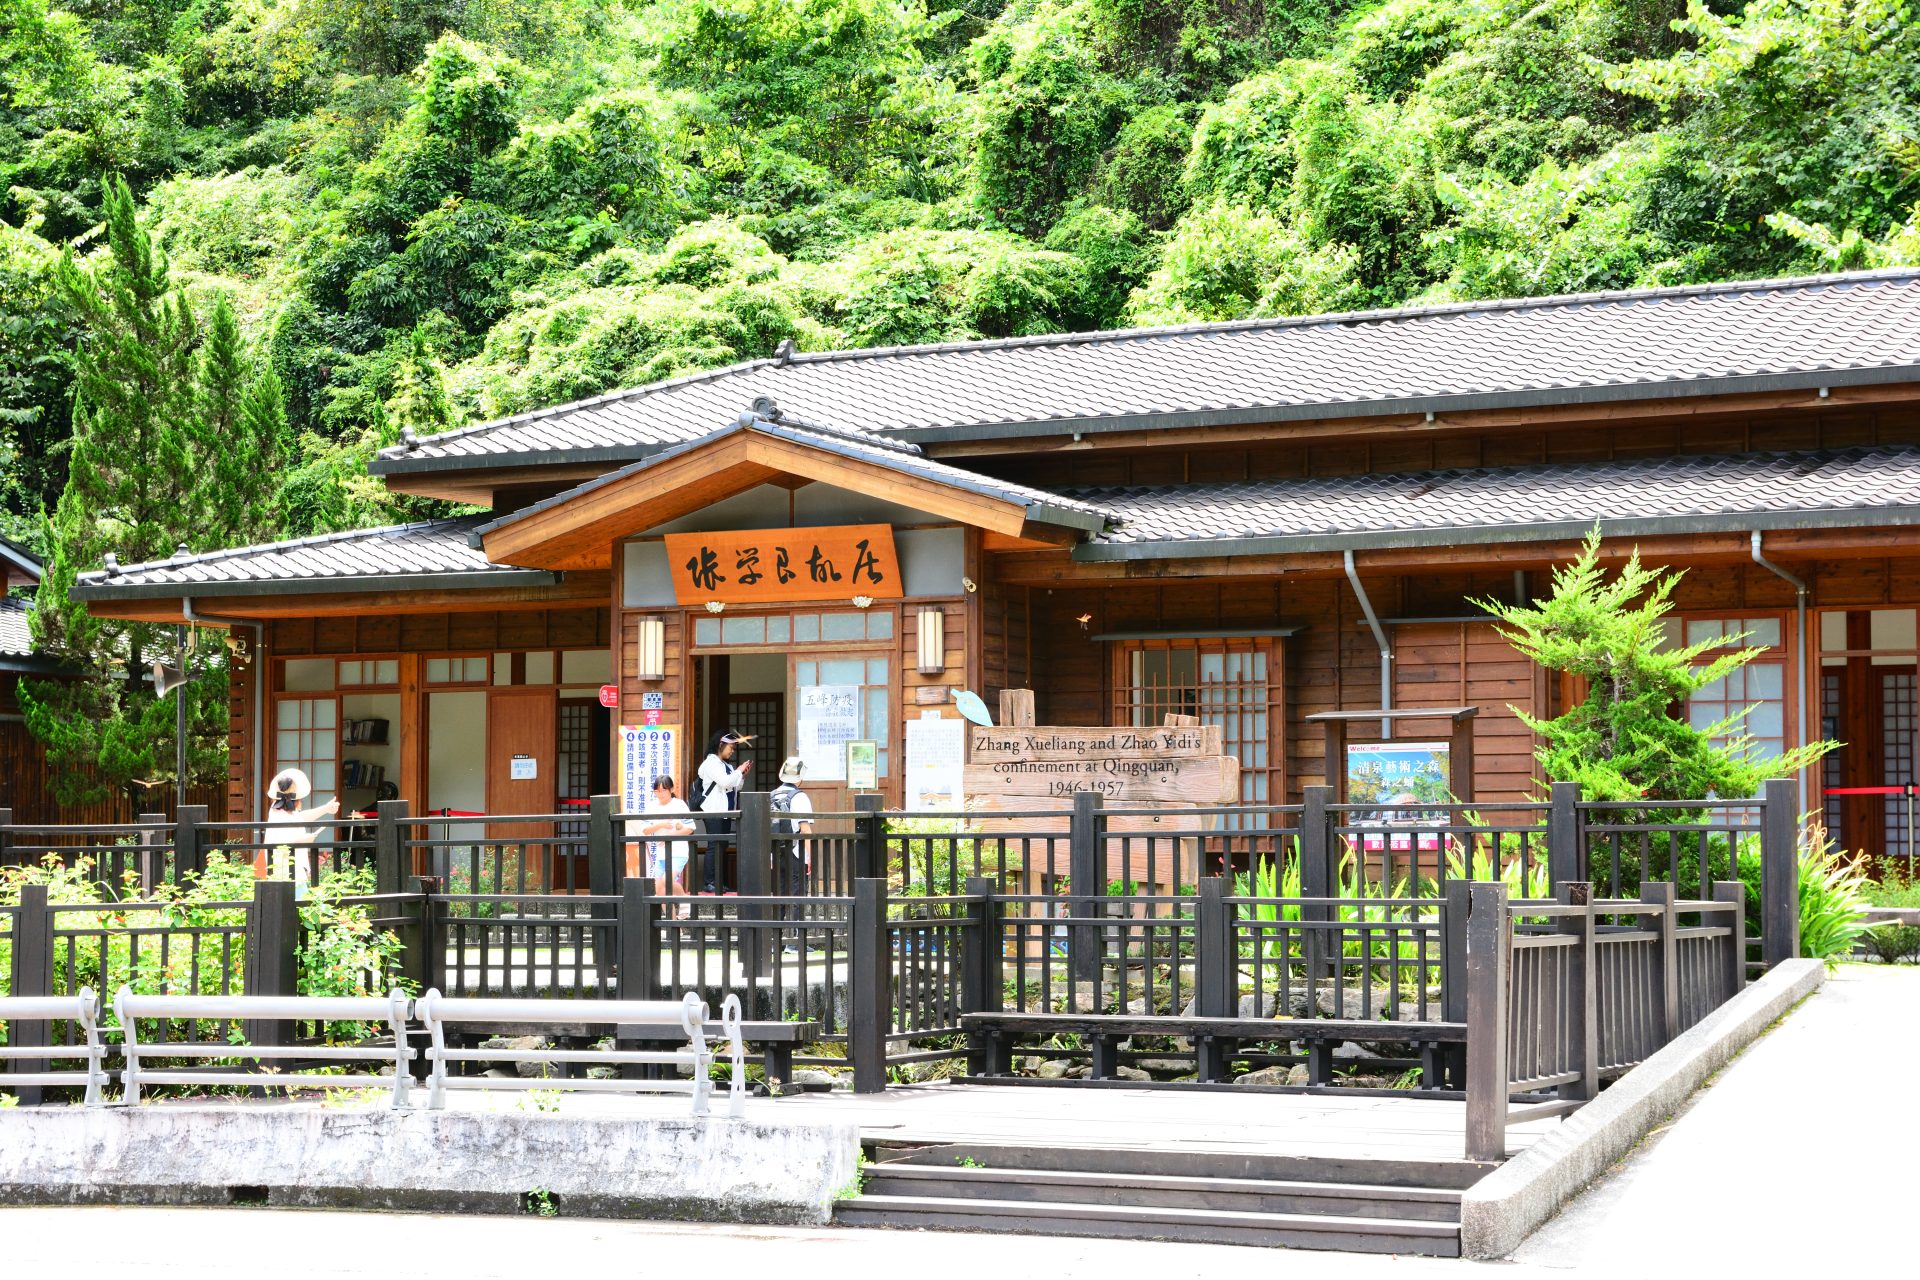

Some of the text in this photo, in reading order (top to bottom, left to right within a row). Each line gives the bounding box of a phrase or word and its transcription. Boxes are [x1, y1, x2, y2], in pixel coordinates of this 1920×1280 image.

[976, 736, 1020, 754] Zhang
[1025, 735, 1086, 755] Xueliang
[1090, 735, 1116, 751] and
[1121, 735, 1158, 751] Zhao
[1162, 733, 1201, 750] Yidi's
[994, 757, 1179, 777] confinement at Qingquan,
[1358, 760, 1440, 774] 清泉藝術之森
[1048, 781, 1124, 796] 1946-1957
